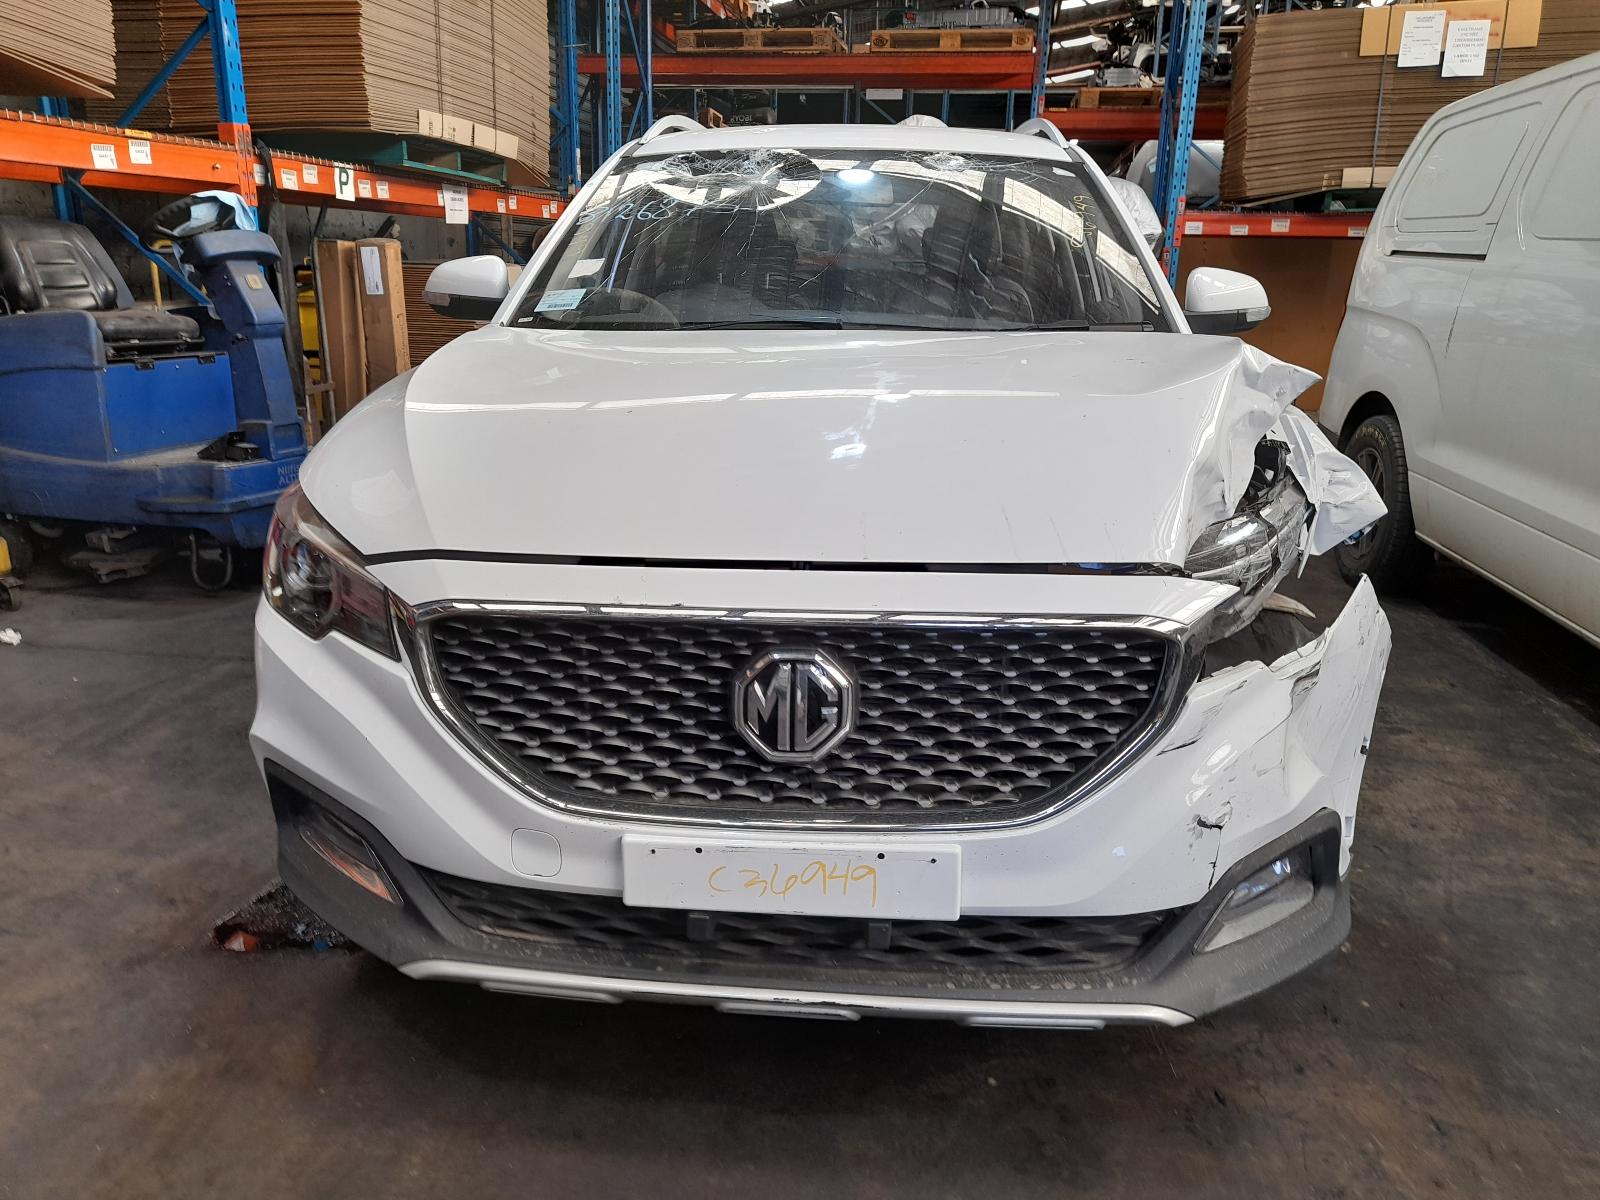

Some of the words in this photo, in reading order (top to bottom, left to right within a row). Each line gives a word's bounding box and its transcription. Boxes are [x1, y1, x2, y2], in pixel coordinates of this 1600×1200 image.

[338, 167, 350, 195] P
[746, 661, 839, 752] MG
[708, 860, 878, 908] C36949
